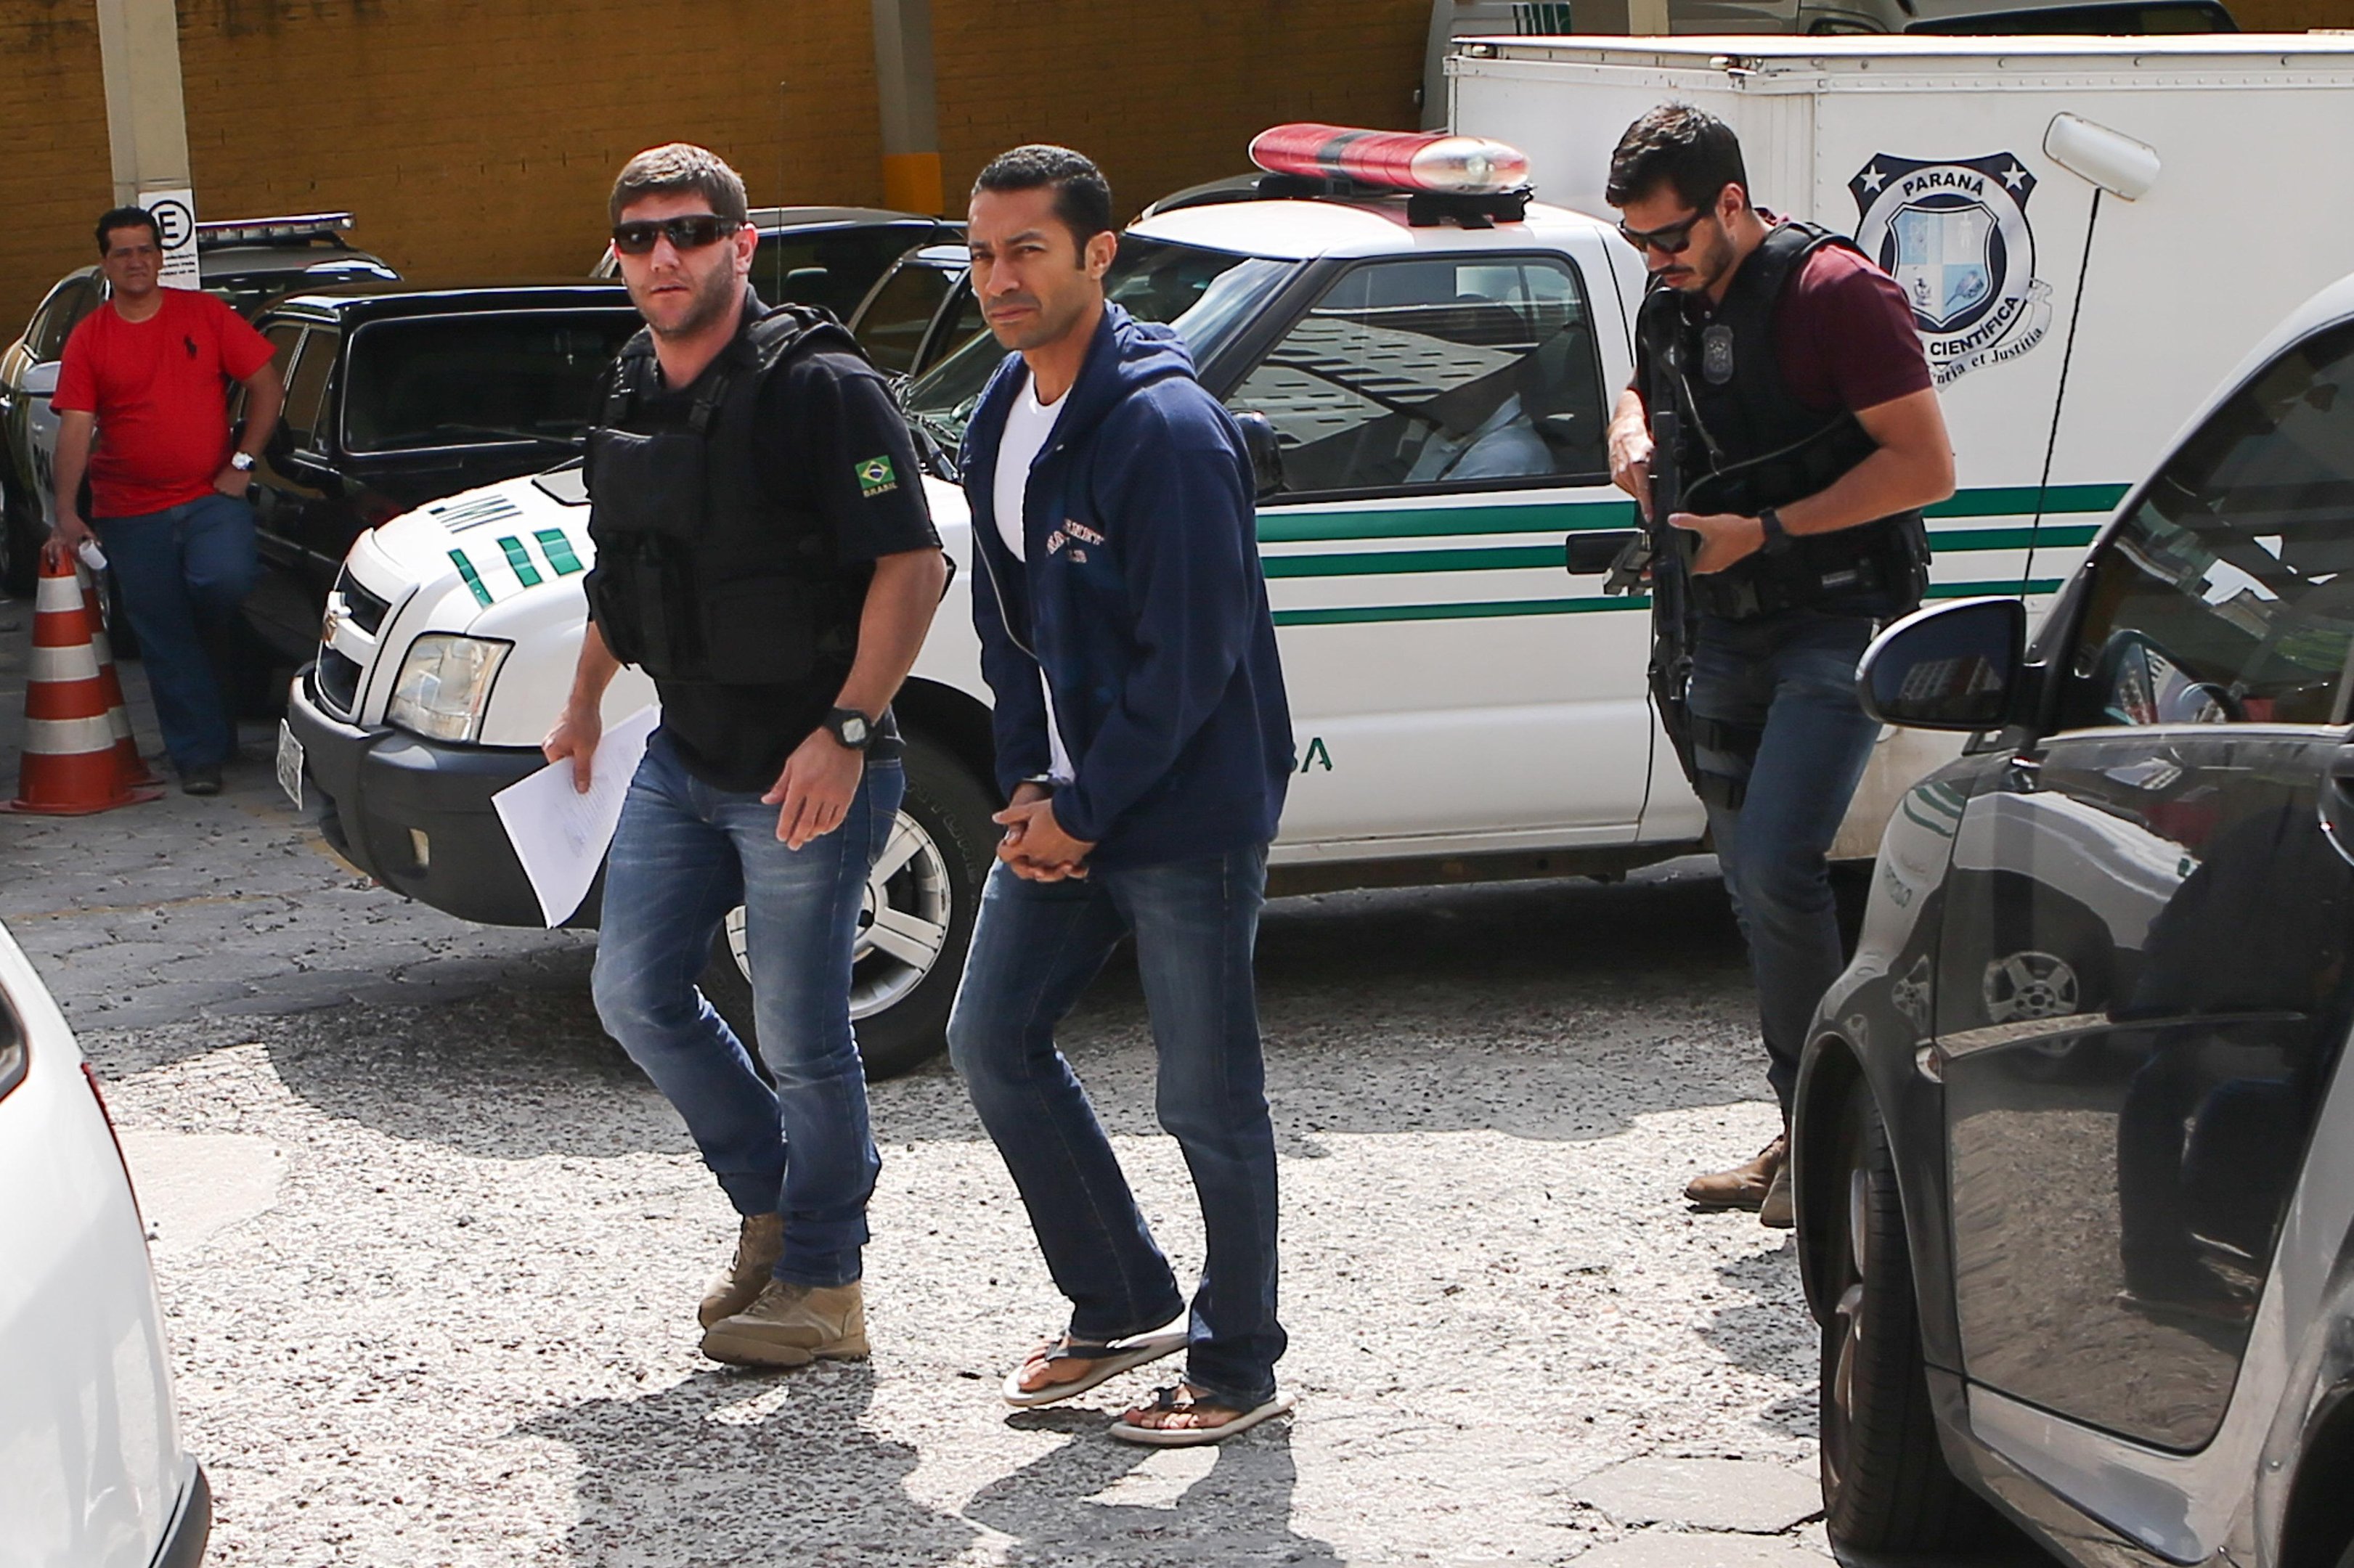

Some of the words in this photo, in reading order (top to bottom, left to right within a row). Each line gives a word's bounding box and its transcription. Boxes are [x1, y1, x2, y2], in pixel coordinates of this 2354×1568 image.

[1902, 172, 1984, 197] PARANÁ
[158, 211, 179, 239] E
[1930, 294, 2020, 356] CIENTÍFICA
[1934, 363, 1966, 384] ntia
[1971, 353, 1986, 368] et
[1991, 327, 2043, 363] Justitia
[863, 482, 898, 498] BRASIL
